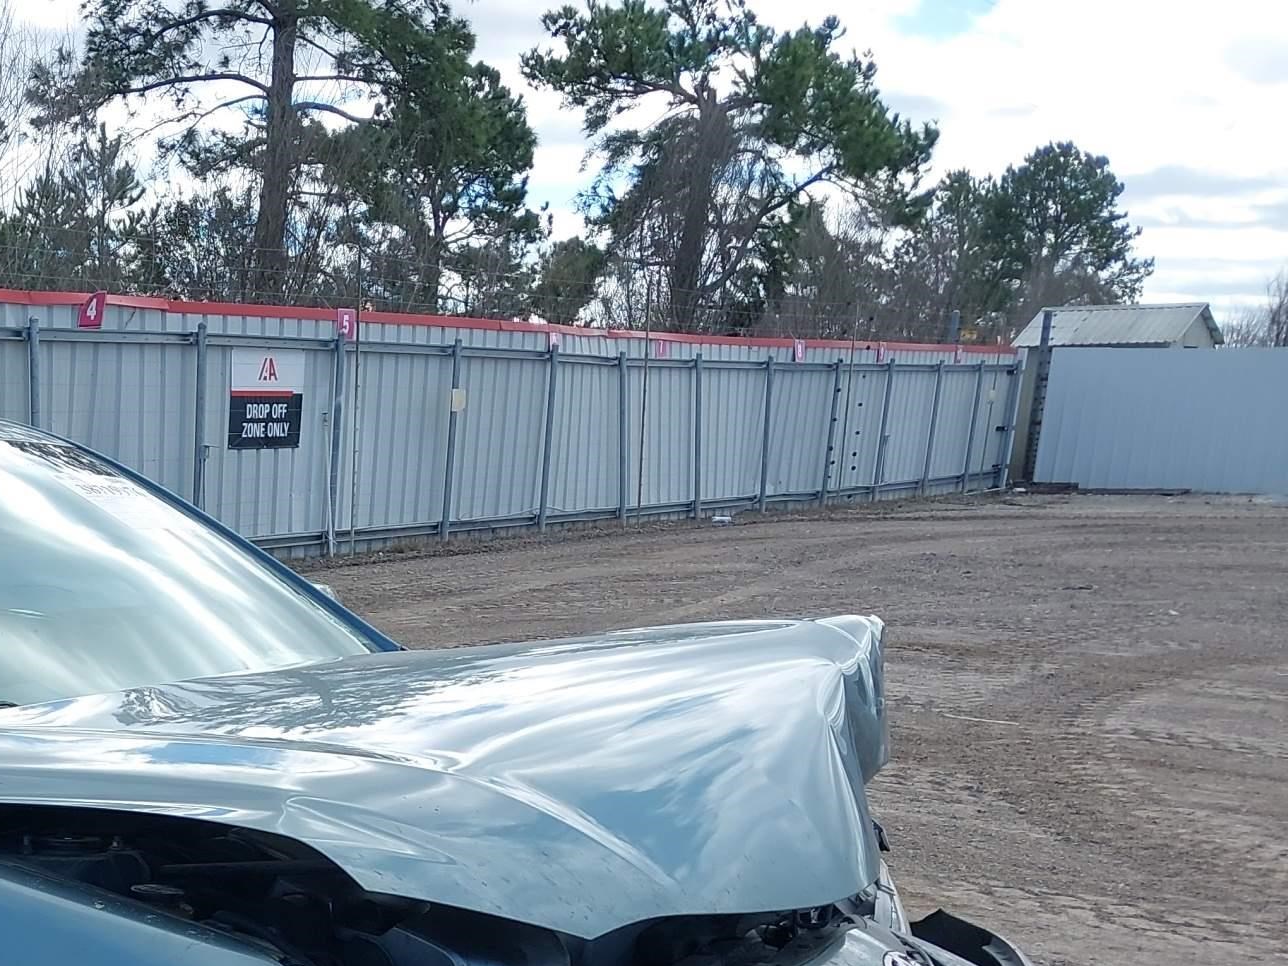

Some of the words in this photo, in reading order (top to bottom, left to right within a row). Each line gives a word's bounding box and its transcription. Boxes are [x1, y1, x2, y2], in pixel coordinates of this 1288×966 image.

[86, 298, 97, 321] 4
[342, 314, 350, 334] 5
[246, 403, 270, 419] DROP
[271, 403, 288, 418] OFF
[242, 422, 266, 438] ZONE
[266, 422, 290, 438] ONLY
